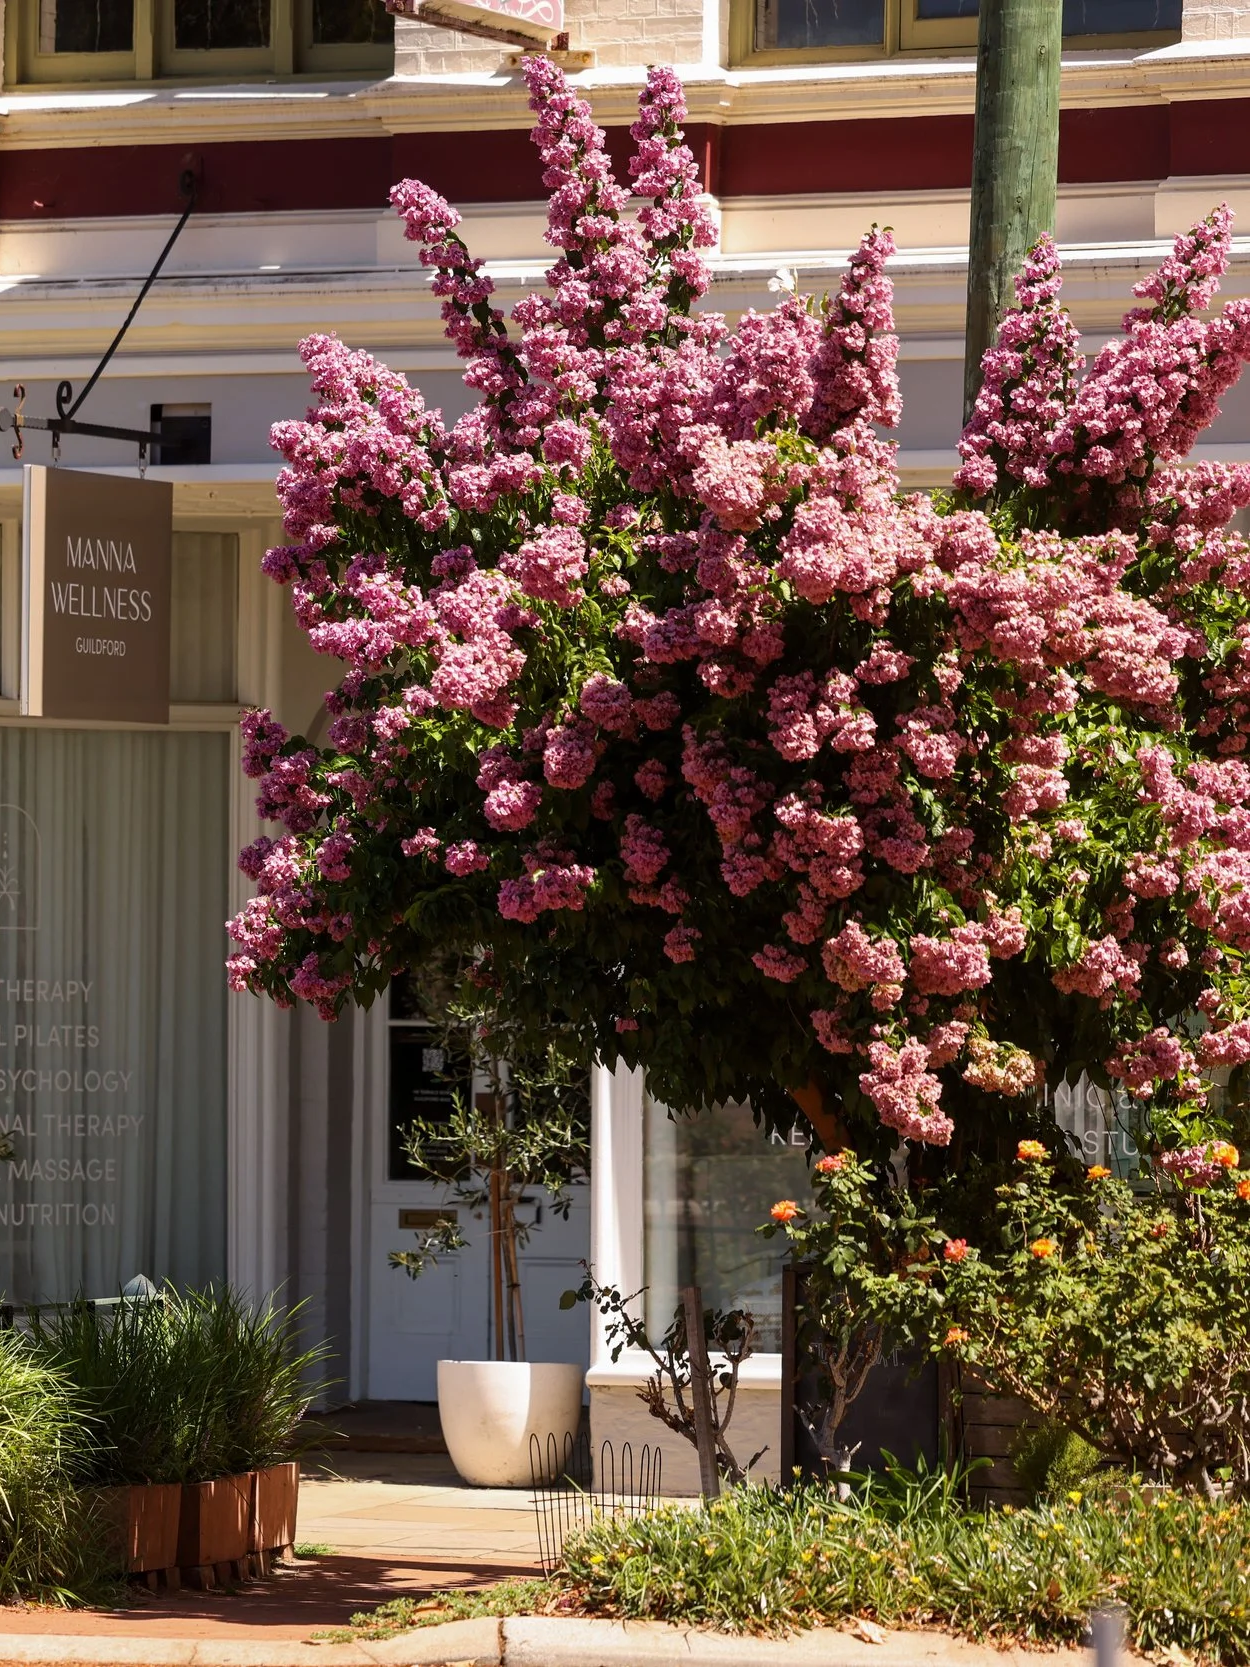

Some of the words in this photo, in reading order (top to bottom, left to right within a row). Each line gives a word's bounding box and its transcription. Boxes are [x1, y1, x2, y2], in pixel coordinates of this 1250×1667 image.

[66, 535, 137, 574] MANNA
[51, 581, 152, 622] WELLNESS
[76, 637, 126, 656] GUILDFORD
[14, 1025, 100, 1048] PILATES
[1035, 1083, 1106, 1108] INIC
[43, 1115, 144, 1137] THERAPY
[7, 1160, 116, 1182] MASSAGE
